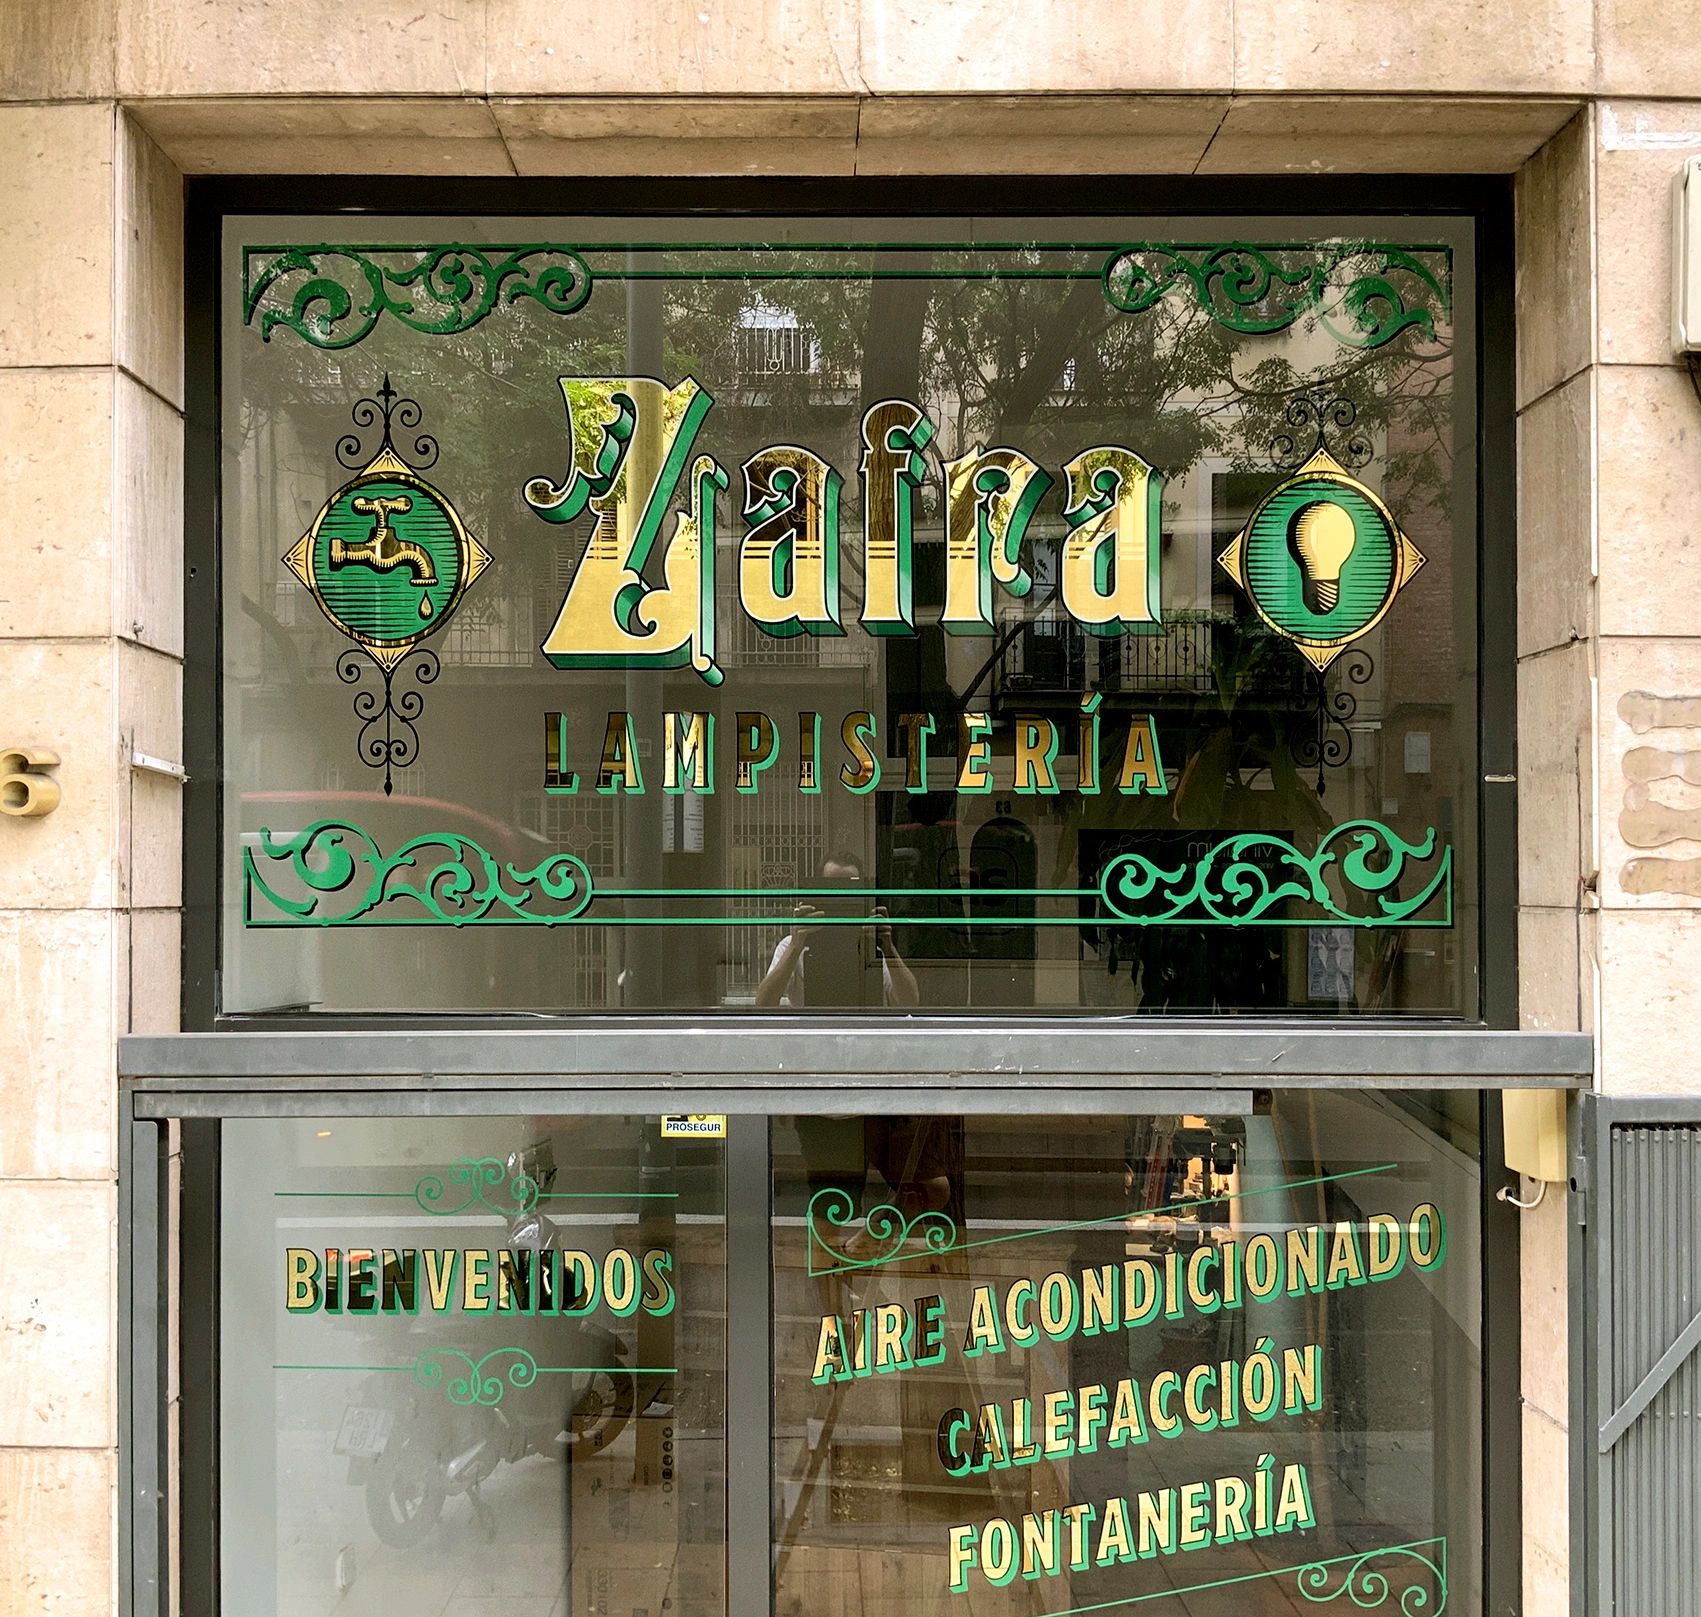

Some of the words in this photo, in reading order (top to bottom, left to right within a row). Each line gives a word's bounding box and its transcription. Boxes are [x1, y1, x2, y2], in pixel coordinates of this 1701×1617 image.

[524, 375, 1166, 686] Zafra
[544, 693, 1167, 795] LAMPISTERÍA
[666, 1122, 721, 1132] PROSEGUR
[285, 1248, 676, 1317] BIENVENIDOS
[810, 1294, 946, 1385] AIRE
[963, 1202, 1448, 1359] ACONDICIONADO
[937, 1336, 1323, 1475] CALEFACCIÓN
[948, 1452, 1315, 1593] FONTANERÍA
